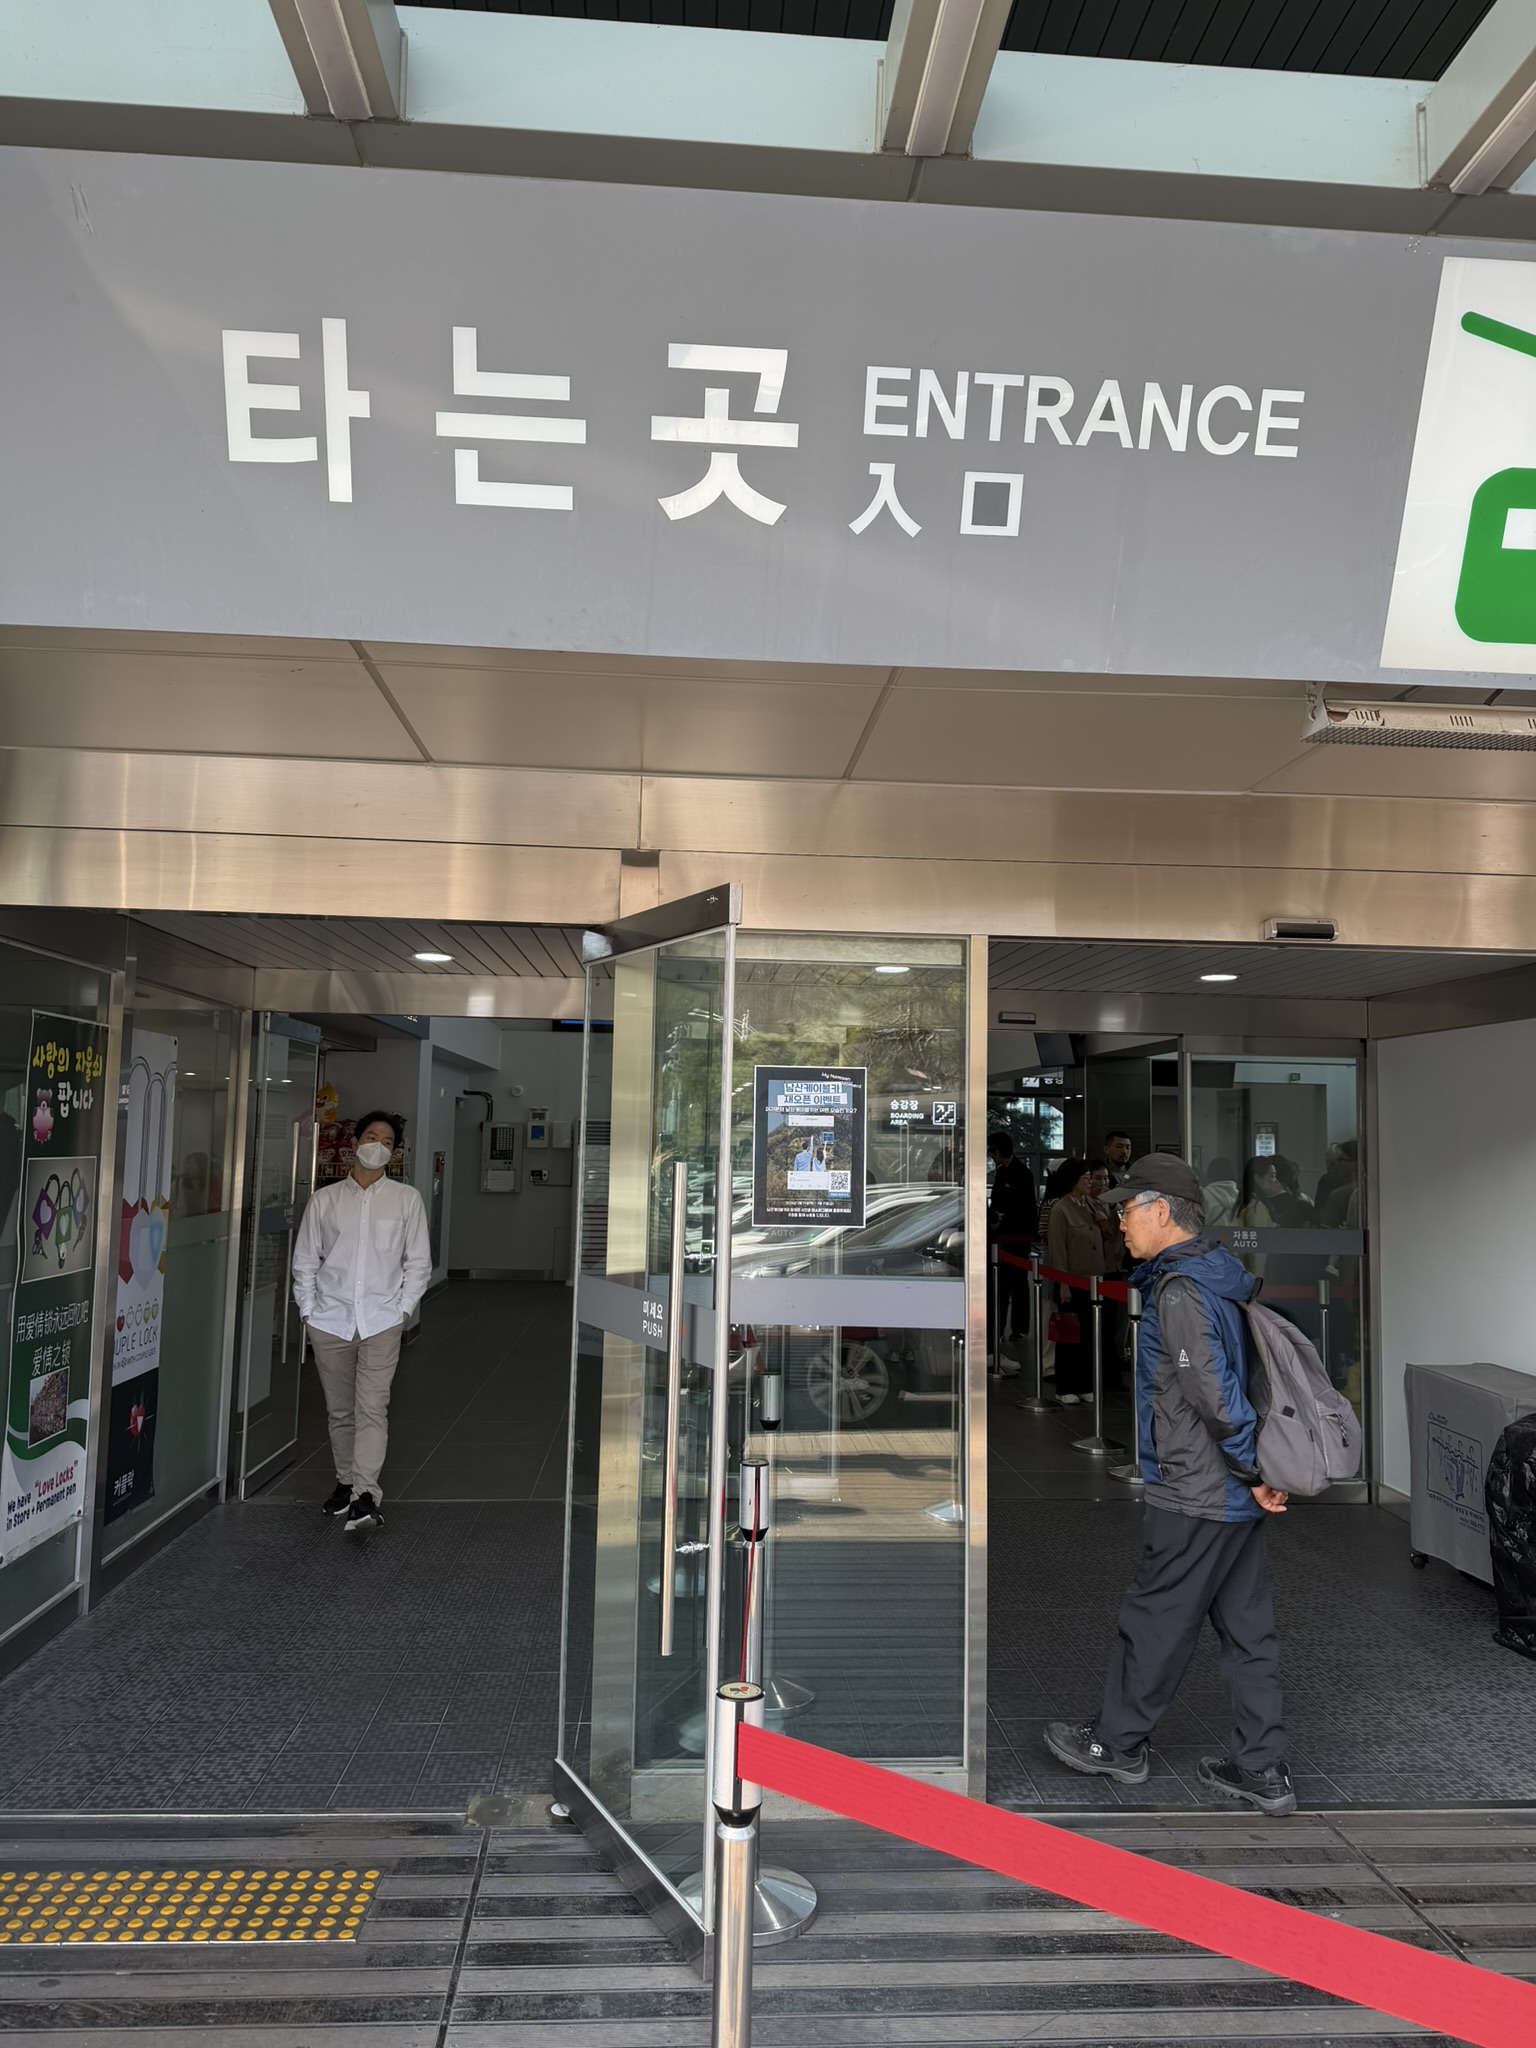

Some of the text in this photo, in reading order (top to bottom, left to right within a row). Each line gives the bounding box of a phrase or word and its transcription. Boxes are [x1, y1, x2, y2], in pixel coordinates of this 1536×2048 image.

[863, 365, 1305, 459] ENTRANCE
[32, 1041, 70, 1079] 사랑의
[785, 1083, 840, 1093] 남산케이블카
[57, 1081, 94, 1118] 팝니다
[783, 1095, 841, 1104] 재오픈 이벤트
[890, 1099, 919, 1111] 승강장
[770, 1229, 796, 1237] AUTO
[1233, 1230, 1257, 1240] 자동문
[1233, 1240, 1258, 1248] AUTO
[642, 1300, 663, 1320] 미세요
[642, 1319, 663, 1339] PUSH
[114, 1325, 158, 1356] UPLE LOCK
[113, 1469, 135, 1497] 커플락
[6, 1517, 13, 1533] in
[13, 1508, 31, 1528] Store
[35, 1487, 66, 1515] Permanent
[66, 1483, 77, 1501] pen
[7, 1499, 16, 1515] We
[16, 1491, 32, 1510] have
